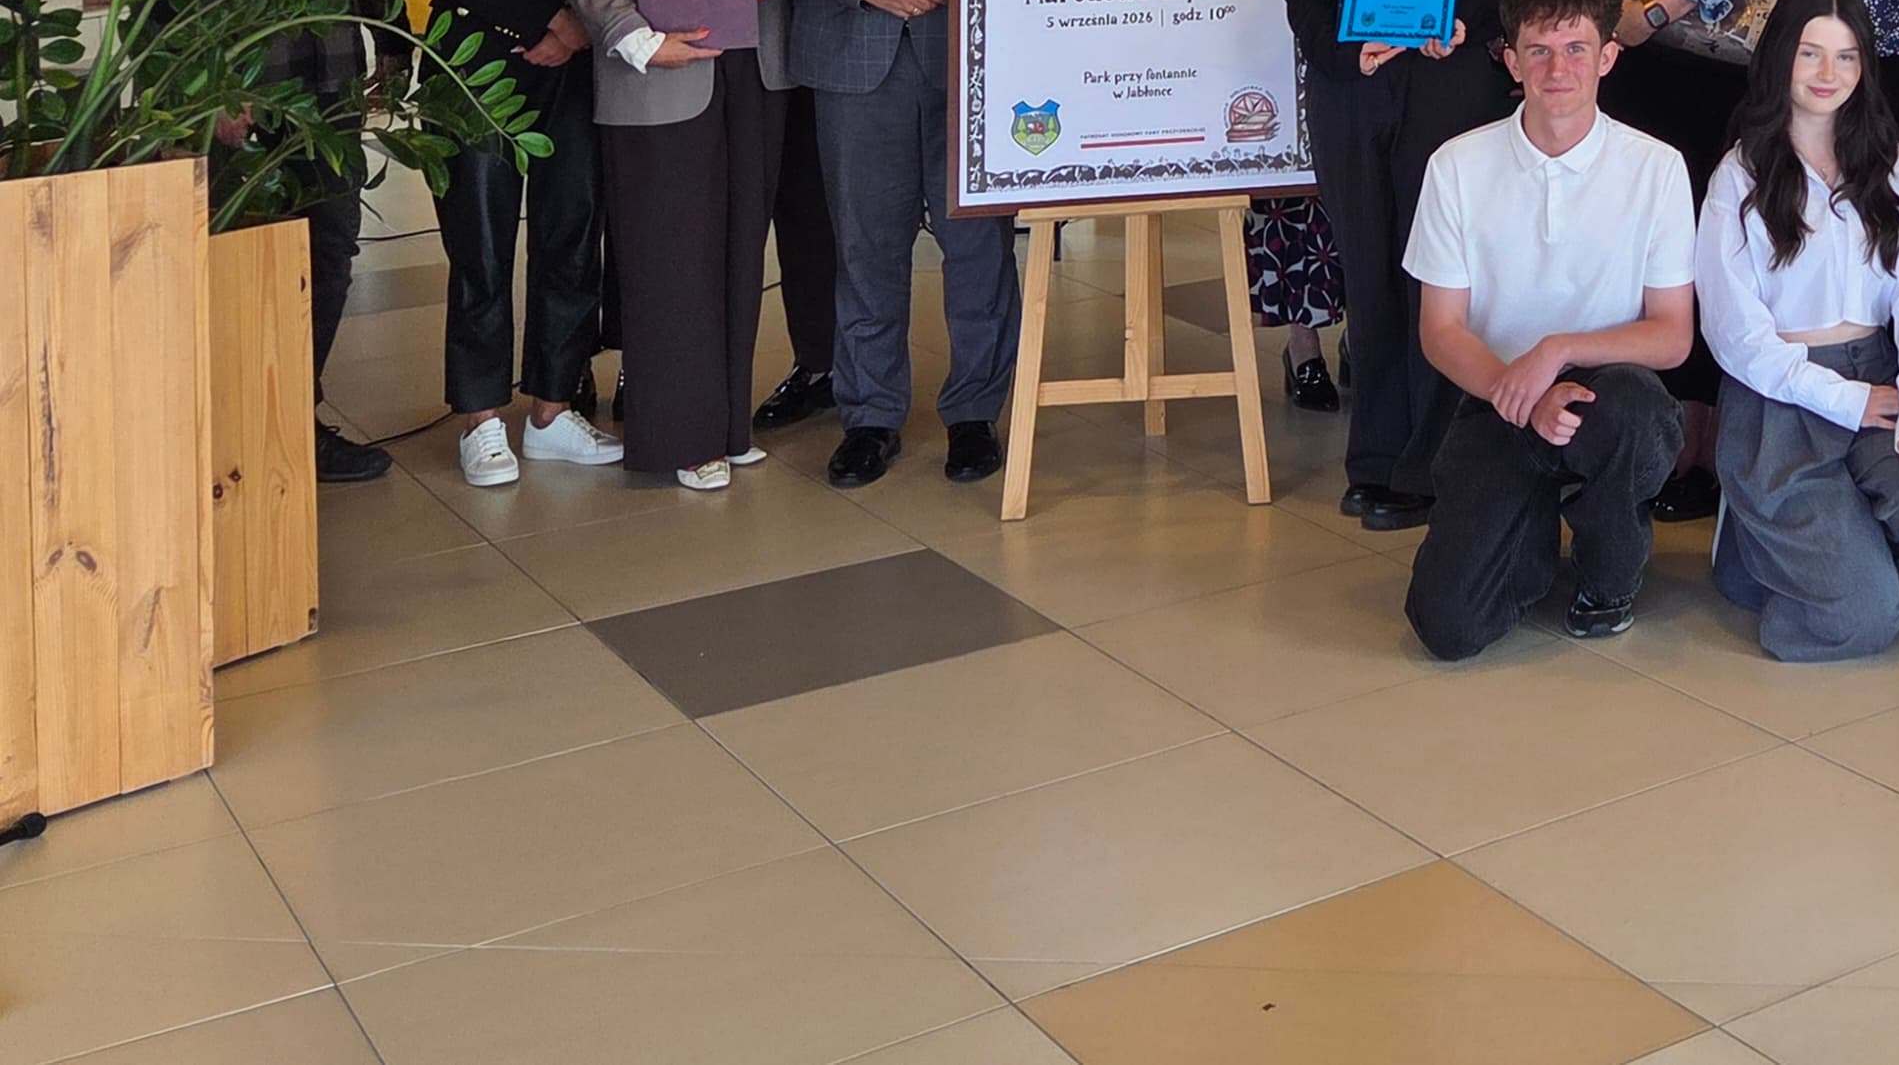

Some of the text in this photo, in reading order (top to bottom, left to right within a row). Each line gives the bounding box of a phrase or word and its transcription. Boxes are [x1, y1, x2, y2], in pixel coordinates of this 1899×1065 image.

[1046, 16, 1055, 28] 5
[1058, 13, 1118, 28] września
[1122, 12, 1153, 25] 2026
[1084, 68, 1198, 87] Park przy fontannie
[1113, 86, 1173, 99] w Jabłonce
